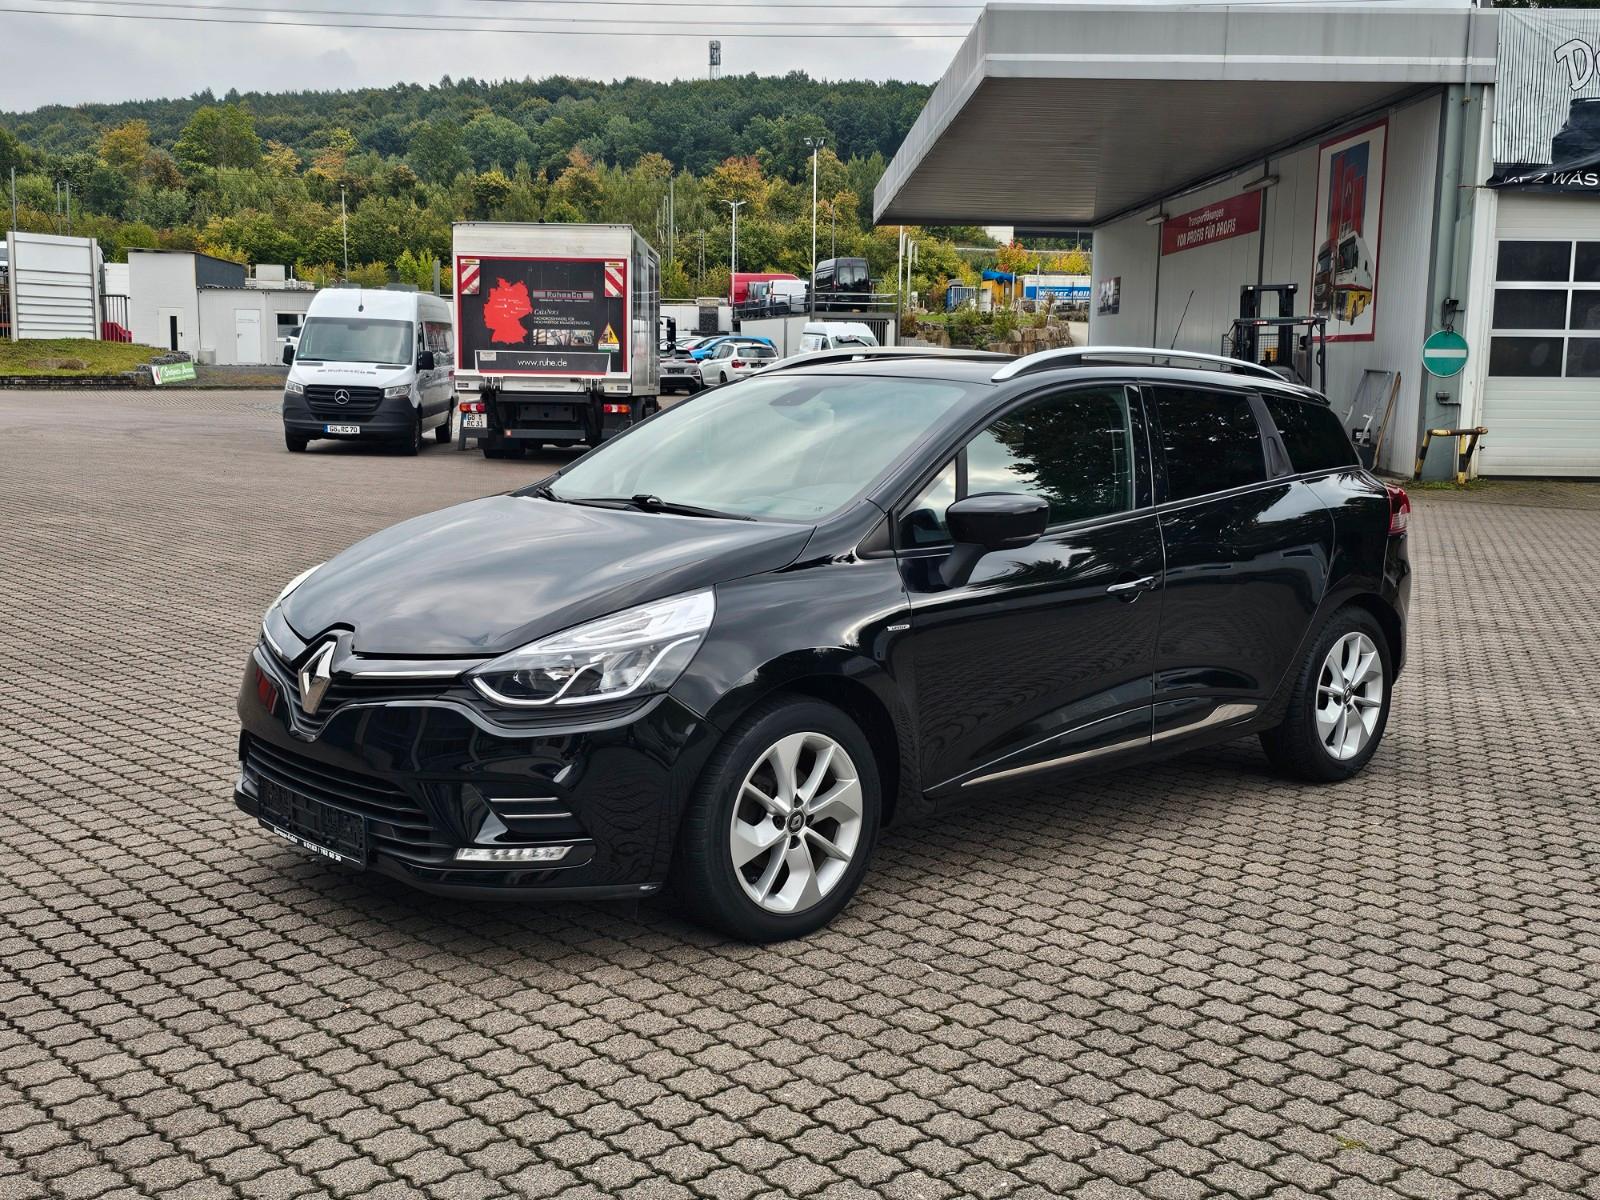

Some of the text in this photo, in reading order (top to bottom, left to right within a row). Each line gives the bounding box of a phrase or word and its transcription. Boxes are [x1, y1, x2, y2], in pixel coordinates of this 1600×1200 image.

[1554, 38, 1600, 91] D
[1177, 218, 1236, 247] VON PROFIS FÜR PROFIS
[517, 358, 568, 367] www.ruhe.de
